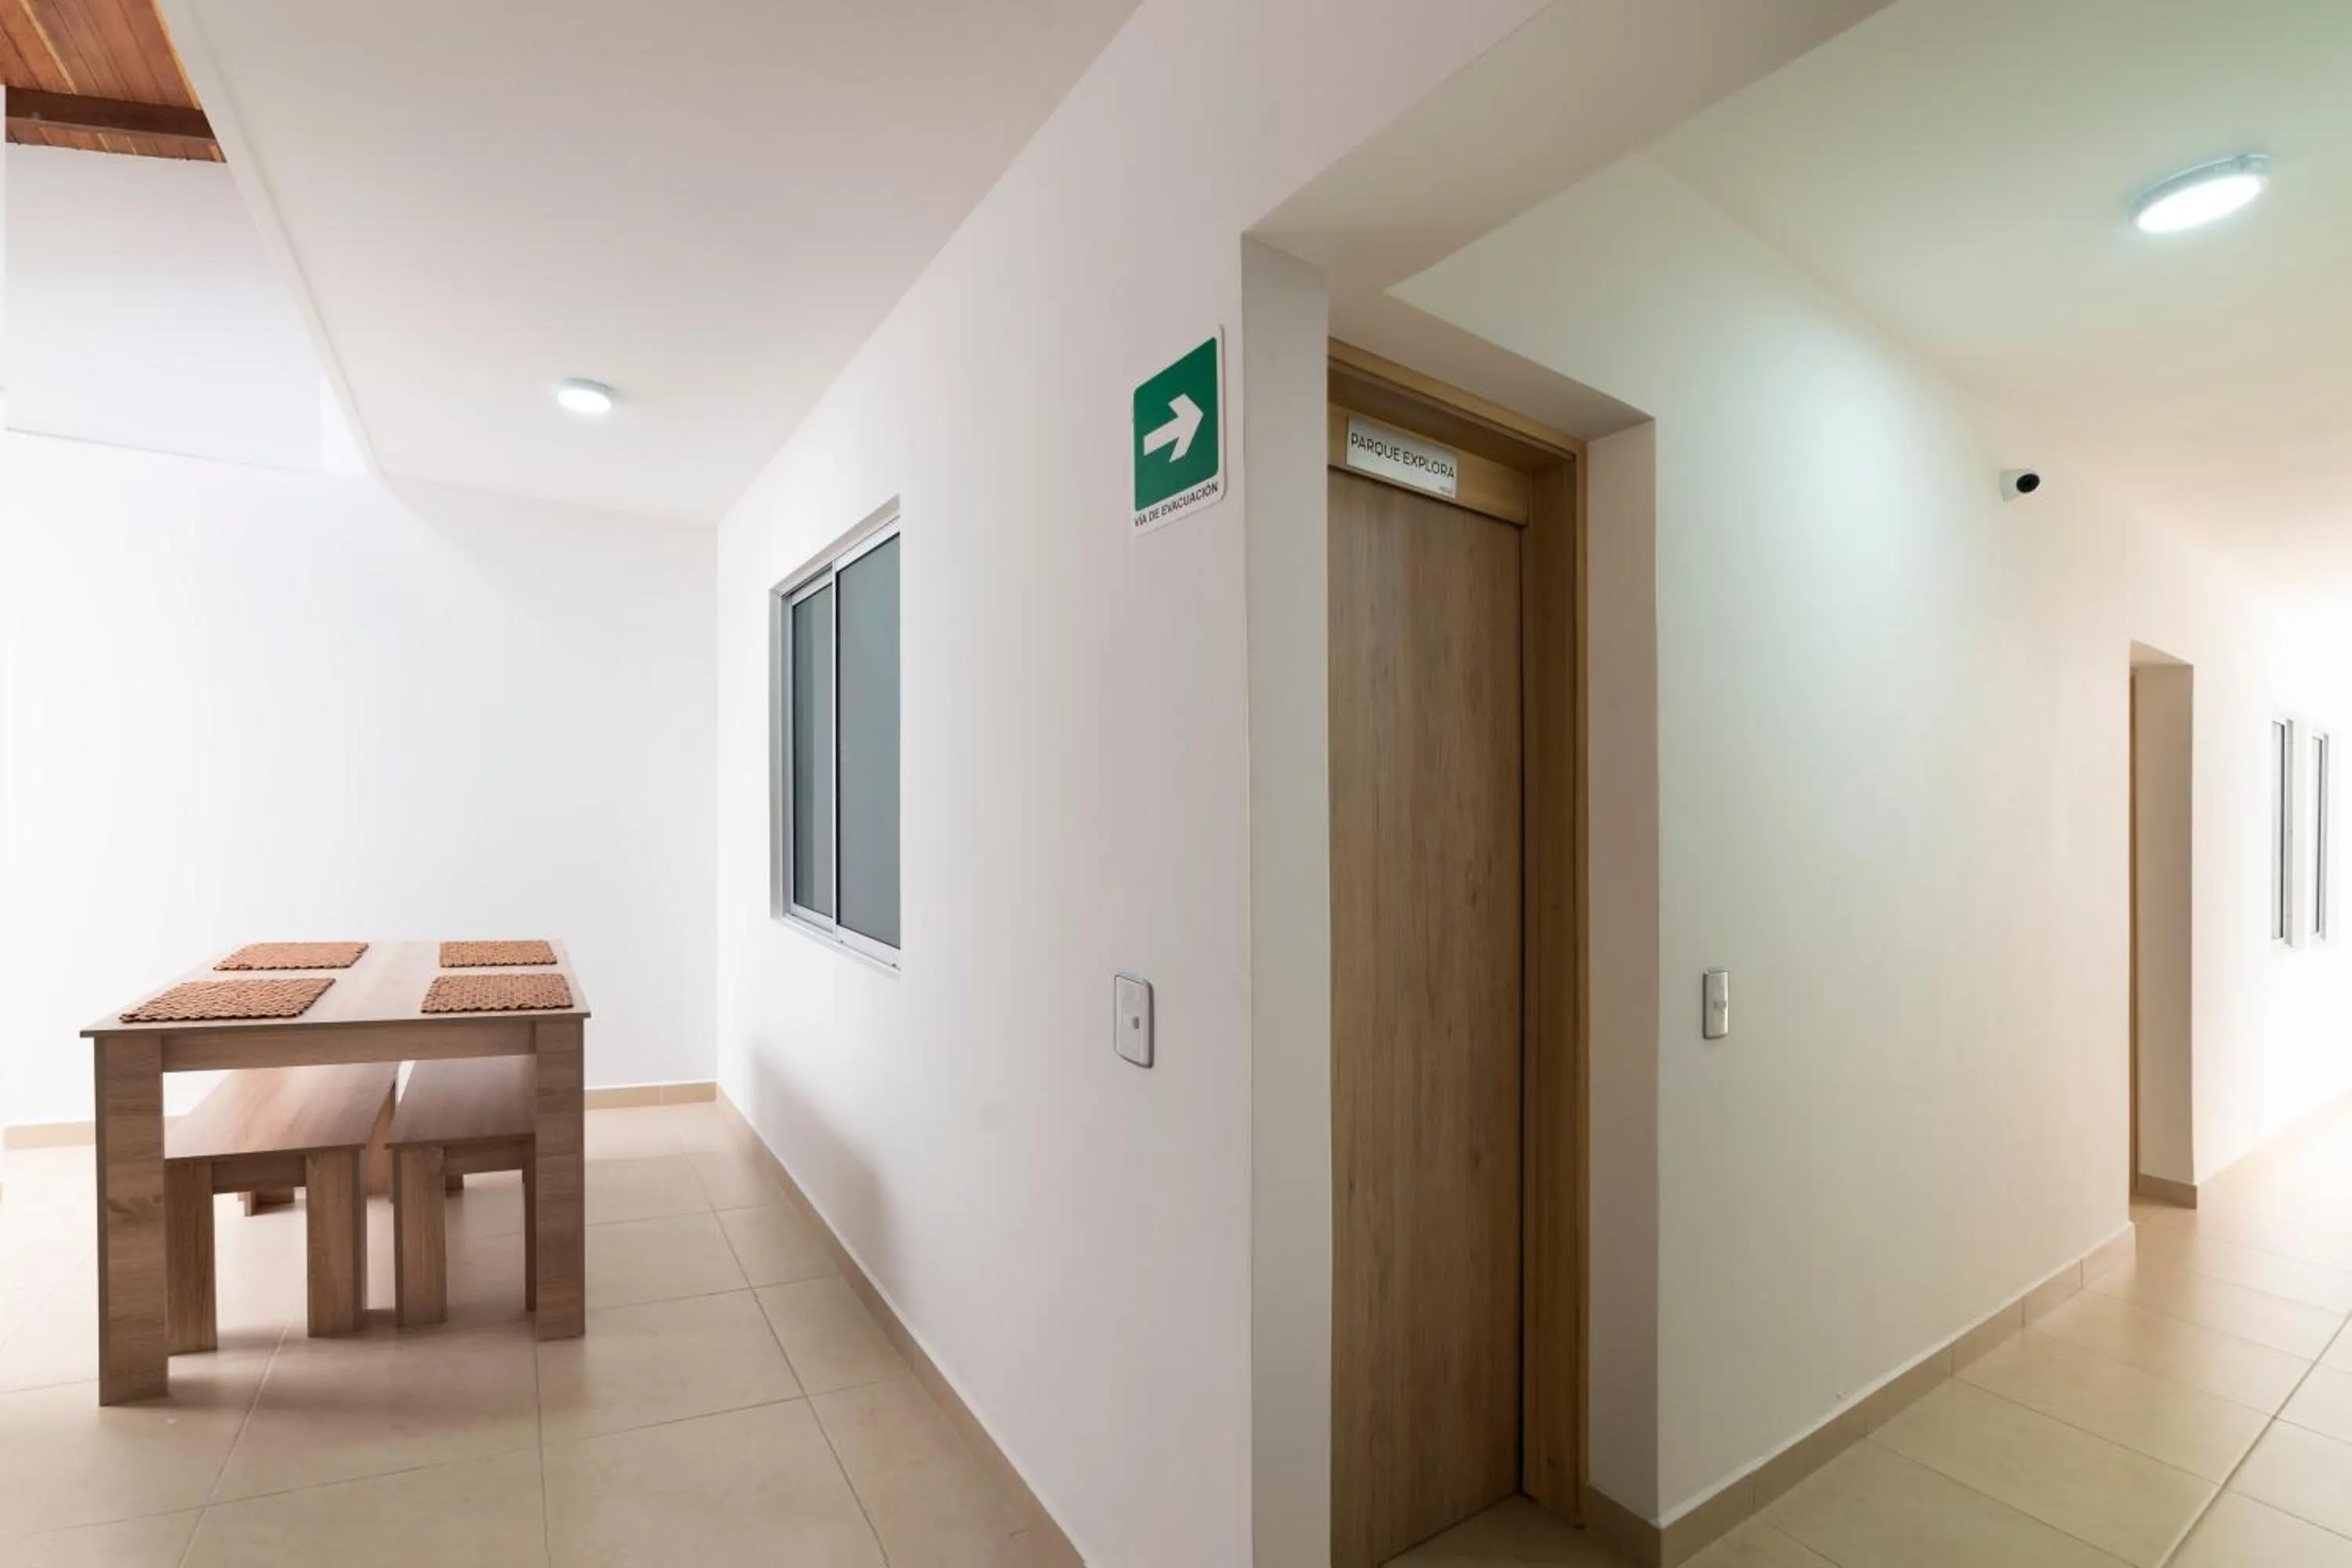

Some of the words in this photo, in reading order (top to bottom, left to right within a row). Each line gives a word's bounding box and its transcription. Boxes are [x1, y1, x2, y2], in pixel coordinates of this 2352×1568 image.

[1351, 432, 1400, 462] PARQUE
[1403, 451, 1454, 477] EXPLORA
[1149, 508, 1160, 521] DE
[1161, 481, 1218, 516] EVACUACIÓN
